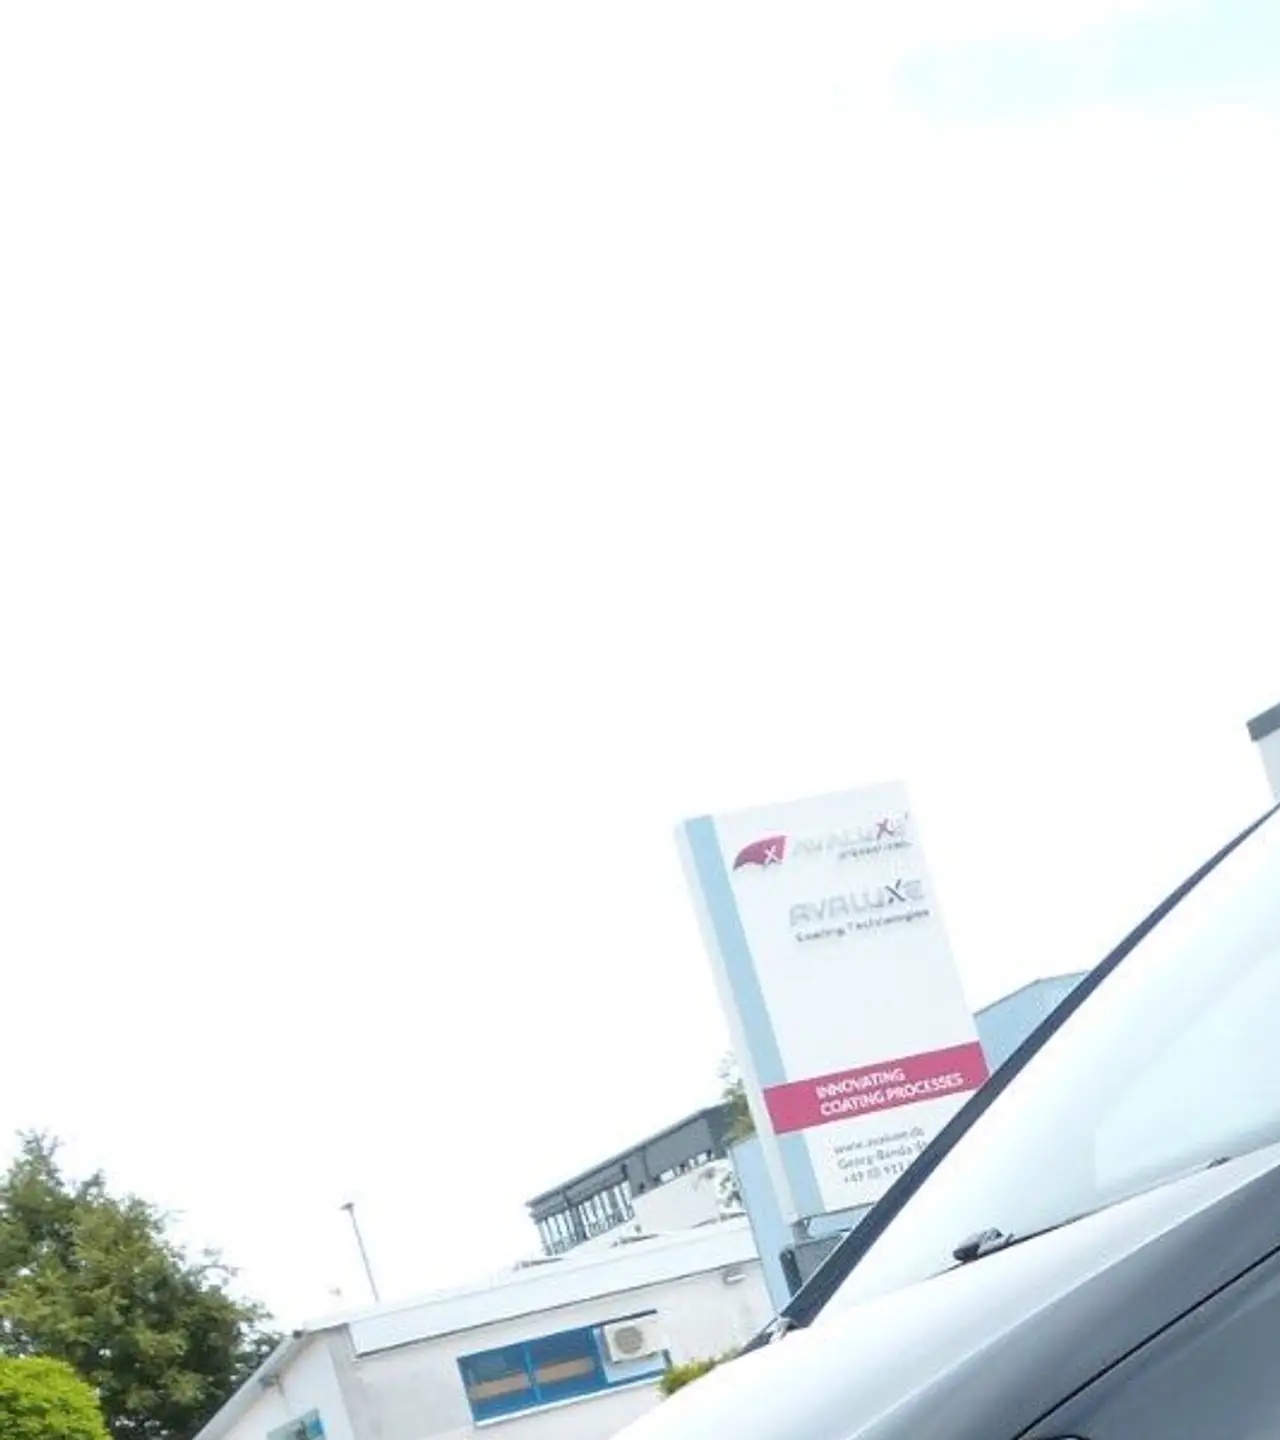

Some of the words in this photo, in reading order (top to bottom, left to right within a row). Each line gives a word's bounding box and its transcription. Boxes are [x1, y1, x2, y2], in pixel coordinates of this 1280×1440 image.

[815, 1067, 907, 1099] INNOVATING
[820, 1090, 886, 1116] COATING
[885, 1071, 965, 1101] PROCESSES
